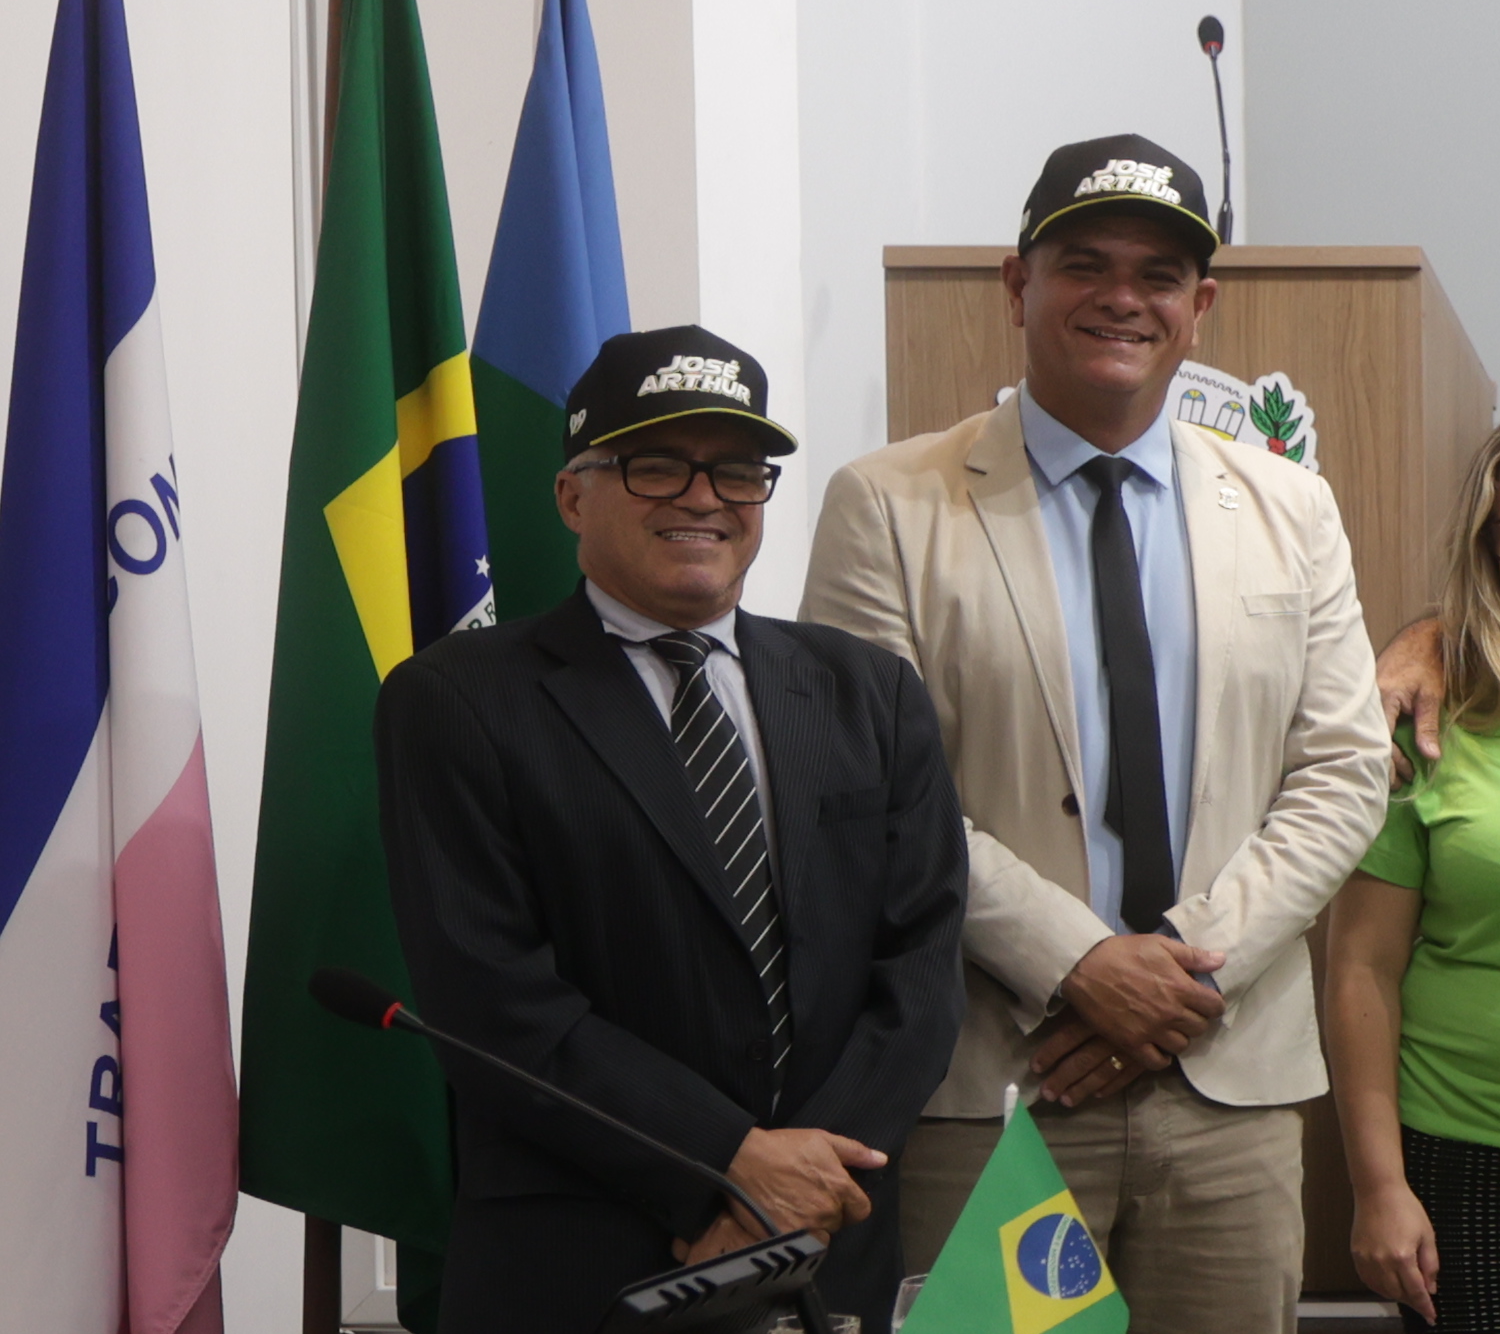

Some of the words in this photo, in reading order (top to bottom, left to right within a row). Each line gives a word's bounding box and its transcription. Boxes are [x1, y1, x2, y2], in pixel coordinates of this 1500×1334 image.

[1092, 159, 1173, 185] JOSÉ
[1074, 175, 1181, 204] ARTHUR
[656, 355, 740, 380] JOSÉ
[637, 373, 751, 406] ARTHUR
